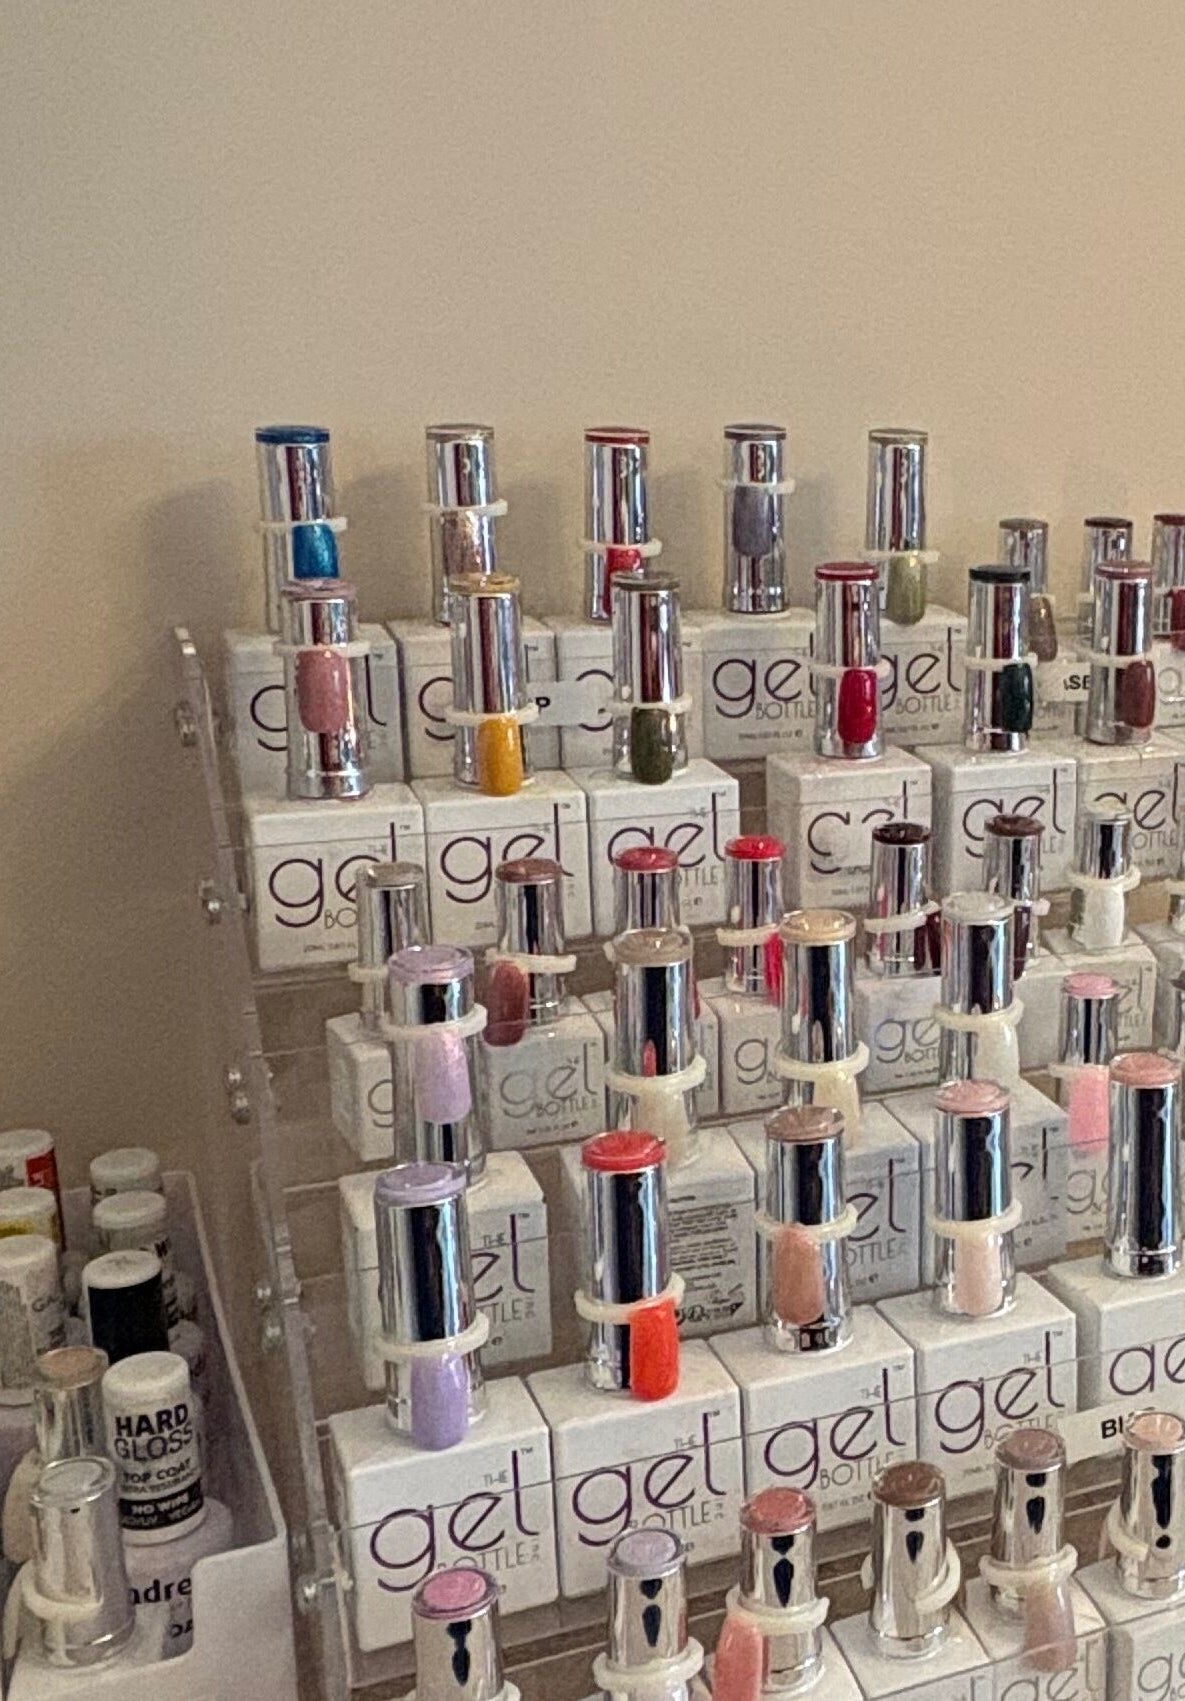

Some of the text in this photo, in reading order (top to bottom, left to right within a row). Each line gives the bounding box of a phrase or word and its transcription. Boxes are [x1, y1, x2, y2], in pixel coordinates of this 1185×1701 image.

[501, 1042, 598, 1118] gel
[843, 1238, 898, 1267] OTTLE
[115, 1403, 188, 1438] HARD
[934, 1330, 1066, 1454] gel
[114, 1421, 194, 1461] GLOSS
[764, 1368, 907, 1490] gel
[1101, 1415, 1124, 1440] BI
[123, 1458, 192, 1484] TOP COAT
[572, 1412, 727, 1547] gel
[370, 1449, 540, 1593] gel
